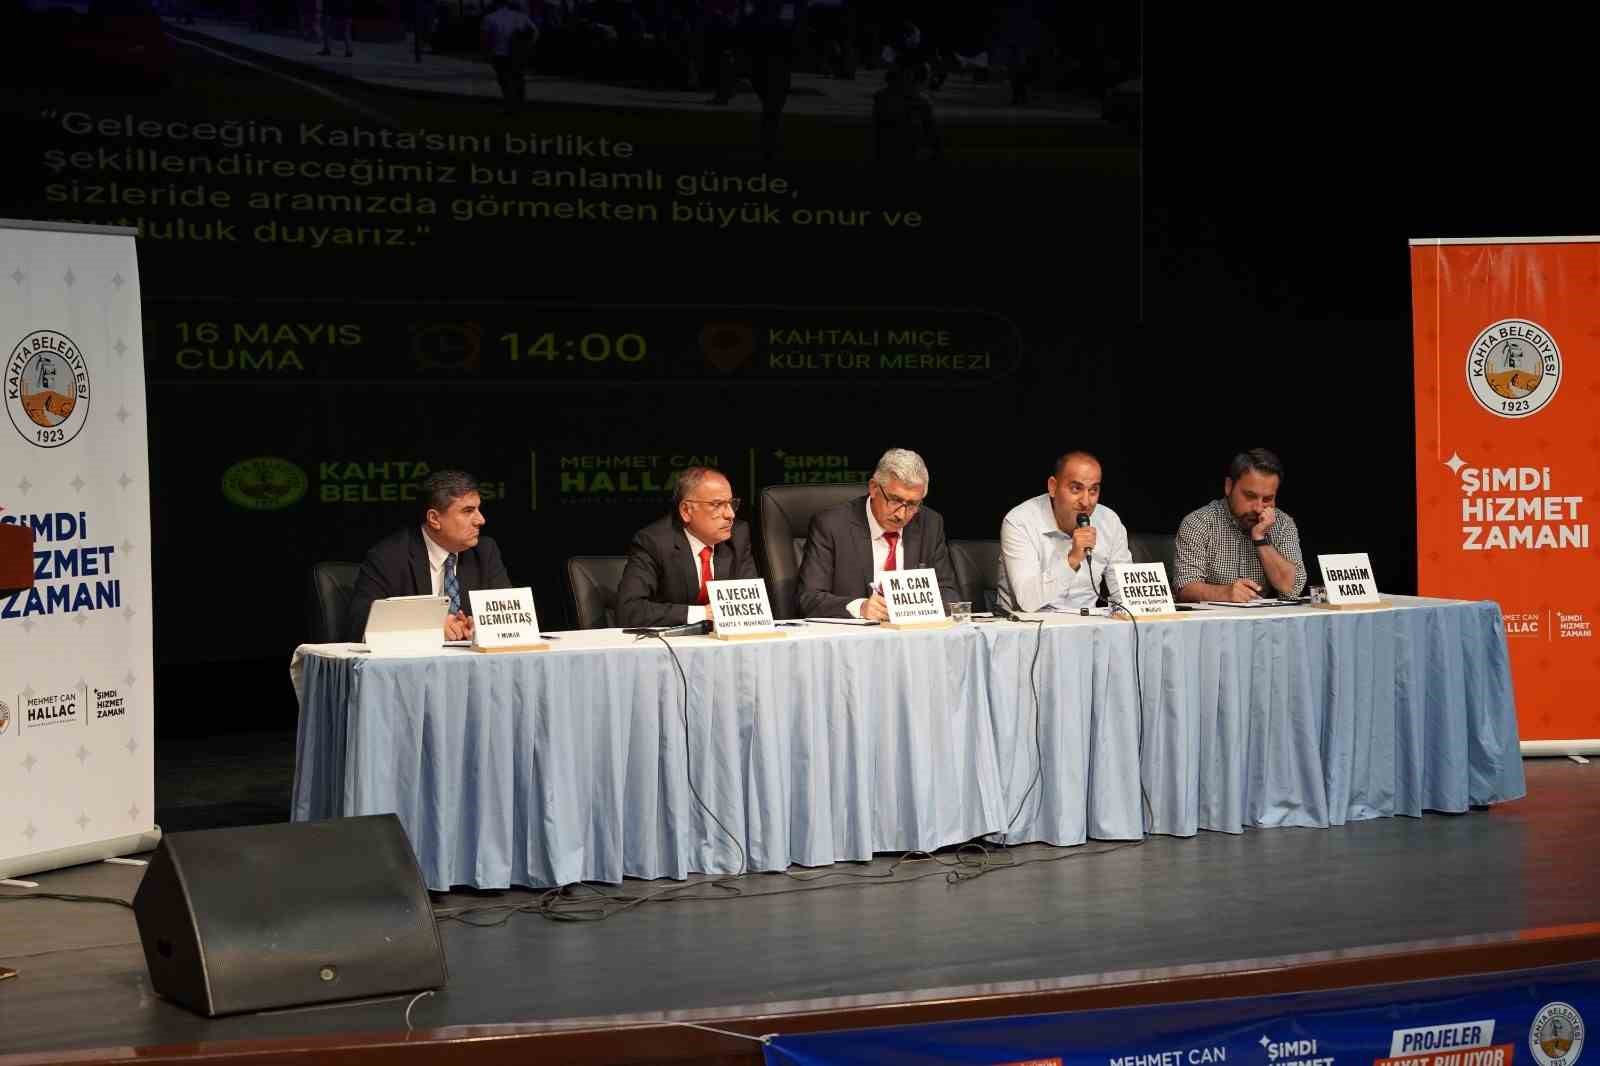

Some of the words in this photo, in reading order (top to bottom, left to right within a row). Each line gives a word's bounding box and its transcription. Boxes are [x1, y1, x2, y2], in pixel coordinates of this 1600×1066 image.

[505, 133, 633, 159] birlikte
[41, 146, 455, 184] şekillendireceğimiz
[471, 163, 517, 185] bu
[530, 166, 663, 192] anlamlı
[676, 173, 799, 199] günde,
[45, 179, 231, 208] sizleride
[248, 190, 436, 214] aramızda
[451, 195, 656, 221] görmekten
[672, 201, 782, 231] büyük
[792, 209, 872, 226] onur
[880, 209, 922, 228] ve
[176, 321, 219, 345] 16
[233, 322, 362, 346] MAYIS
[498, 332, 648, 362] 14:00
[1473, 334, 1499, 377] KAHTA
[175, 349, 304, 370] CUMA
[769, 350, 871, 368] KÜLTÜR
[9, 347, 32, 400] KAHTA
[1501, 401, 1530, 411] 1923
[37, 428, 64, 443] 1923
[320, 461, 432, 480] KAHTA
[560, 455, 657, 468] MEHMET
[669, 455, 719, 467] CAN
[1462, 524, 1589, 550] ZAMANI
[1123, 570, 1161, 584] FAYSAL
[1326, 566, 1370, 581] İBRAHİM
[890, 578, 904, 591] M.
[907, 577, 930, 590] CAN
[1124, 585, 1168, 598] ERKEZEN
[1338, 583, 1366, 596] KARA
[1, 580, 120, 619] ZAMANI
[486, 599, 520, 612] ADNAN
[892, 591, 934, 607] HALLAÇ
[719, 601, 764, 617] YÜKSEK
[479, 612, 532, 626] DEMİRTAŞ
[27, 694, 58, 707] MEHMET
[60, 693, 76, 703] CAN
[1402, 1025, 1482, 1053] PROJELER
[1189, 1046, 1226, 1065] CAN
